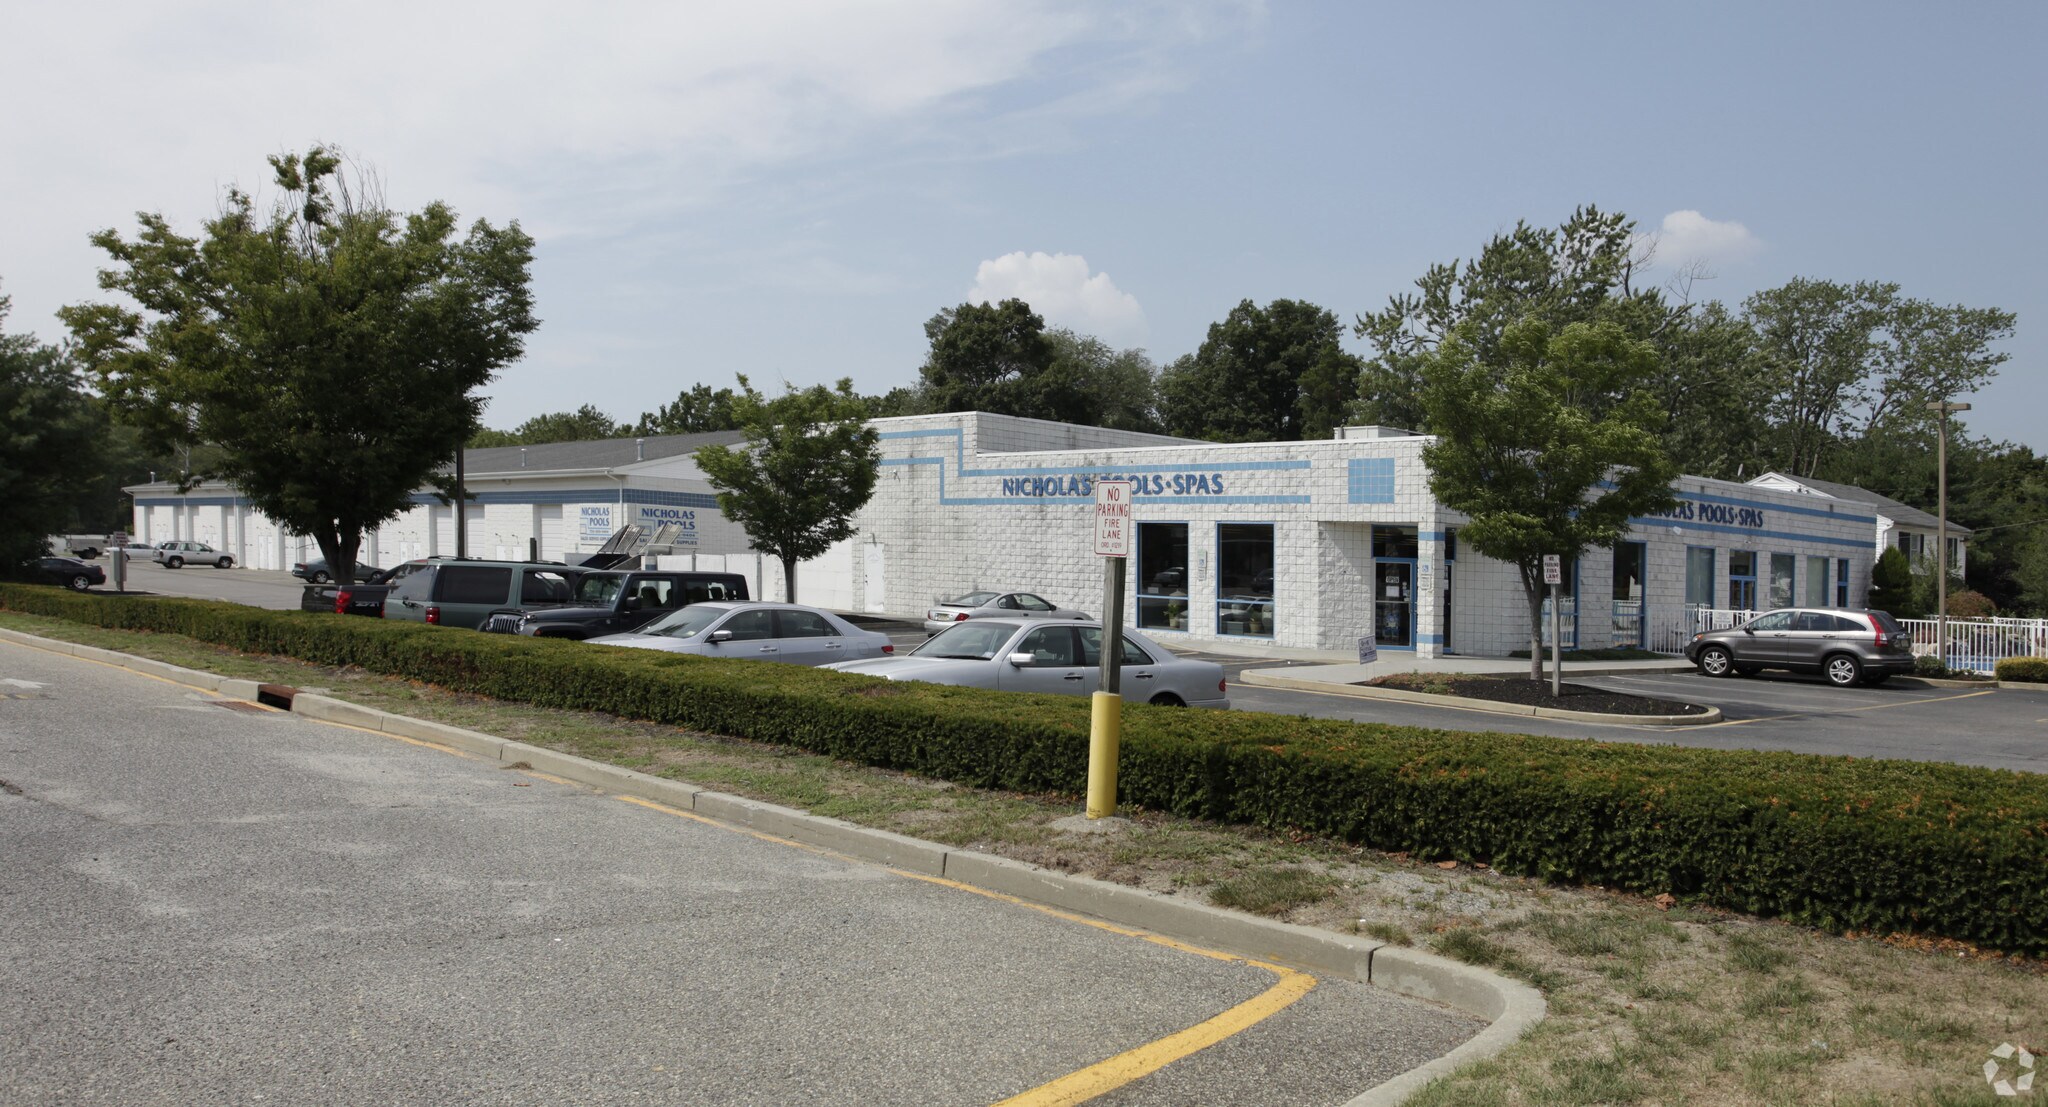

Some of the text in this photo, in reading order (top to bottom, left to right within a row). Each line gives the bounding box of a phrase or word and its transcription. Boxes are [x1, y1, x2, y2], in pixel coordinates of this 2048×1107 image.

[1003, 475, 1092, 496] NICHOLAS
[1100, 474, 1164, 495] OLS
[1107, 487, 1120, 501] NO
[581, 507, 610, 516] NICHOLAS
[641, 508, 695, 520] NICHOLAS
[1097, 503, 1128, 517] PARKING
[589, 517, 610, 527] POOLS
[1104, 518, 1120, 528] FIRE
[1102, 530, 1121, 539] LANE
